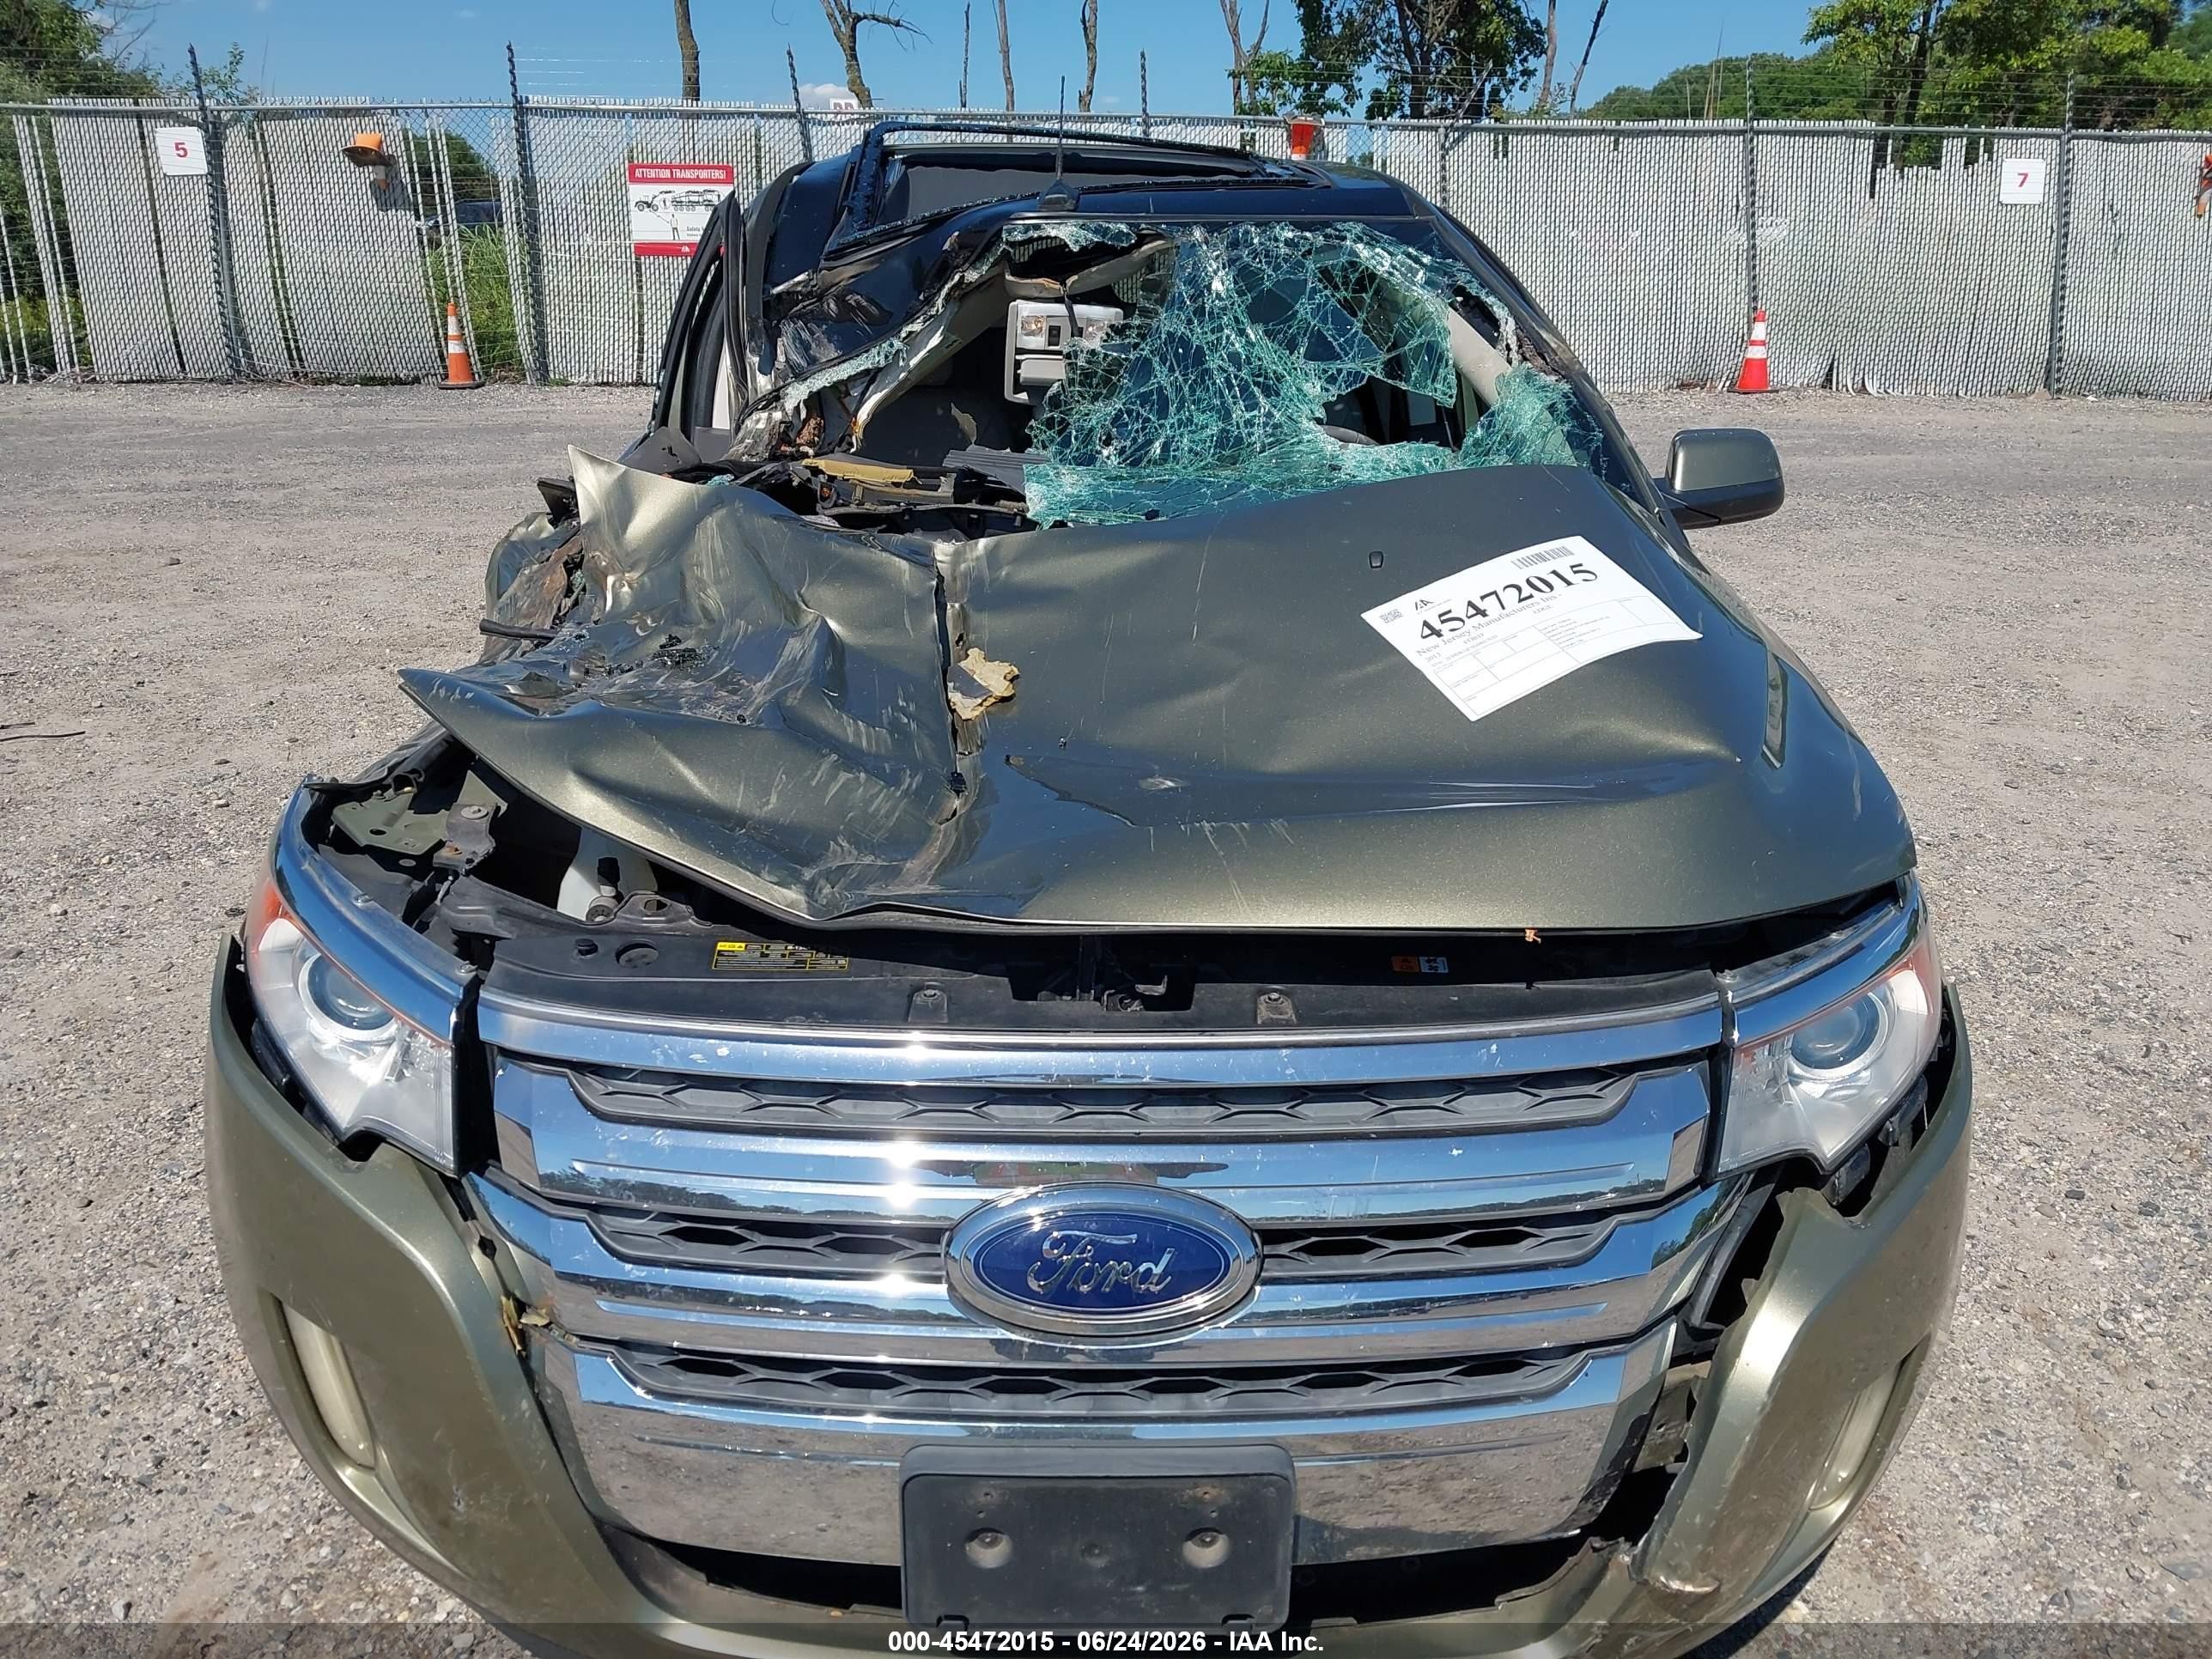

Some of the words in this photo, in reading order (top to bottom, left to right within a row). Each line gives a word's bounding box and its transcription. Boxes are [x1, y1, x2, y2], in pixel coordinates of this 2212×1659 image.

[174, 142, 188, 158] 5
[635, 168, 671, 179] ATTENTION
[672, 168, 726, 179] TRANSPORTERS!
[2018, 173, 2028, 187] 7
[1420, 563, 1598, 639] 45472015
[1416, 644, 1440, 656] New
[1442, 629, 1471, 645] Jersey
[1471, 601, 1540, 631] Manufacturers
[1026, 1230, 1176, 1293] Ford
